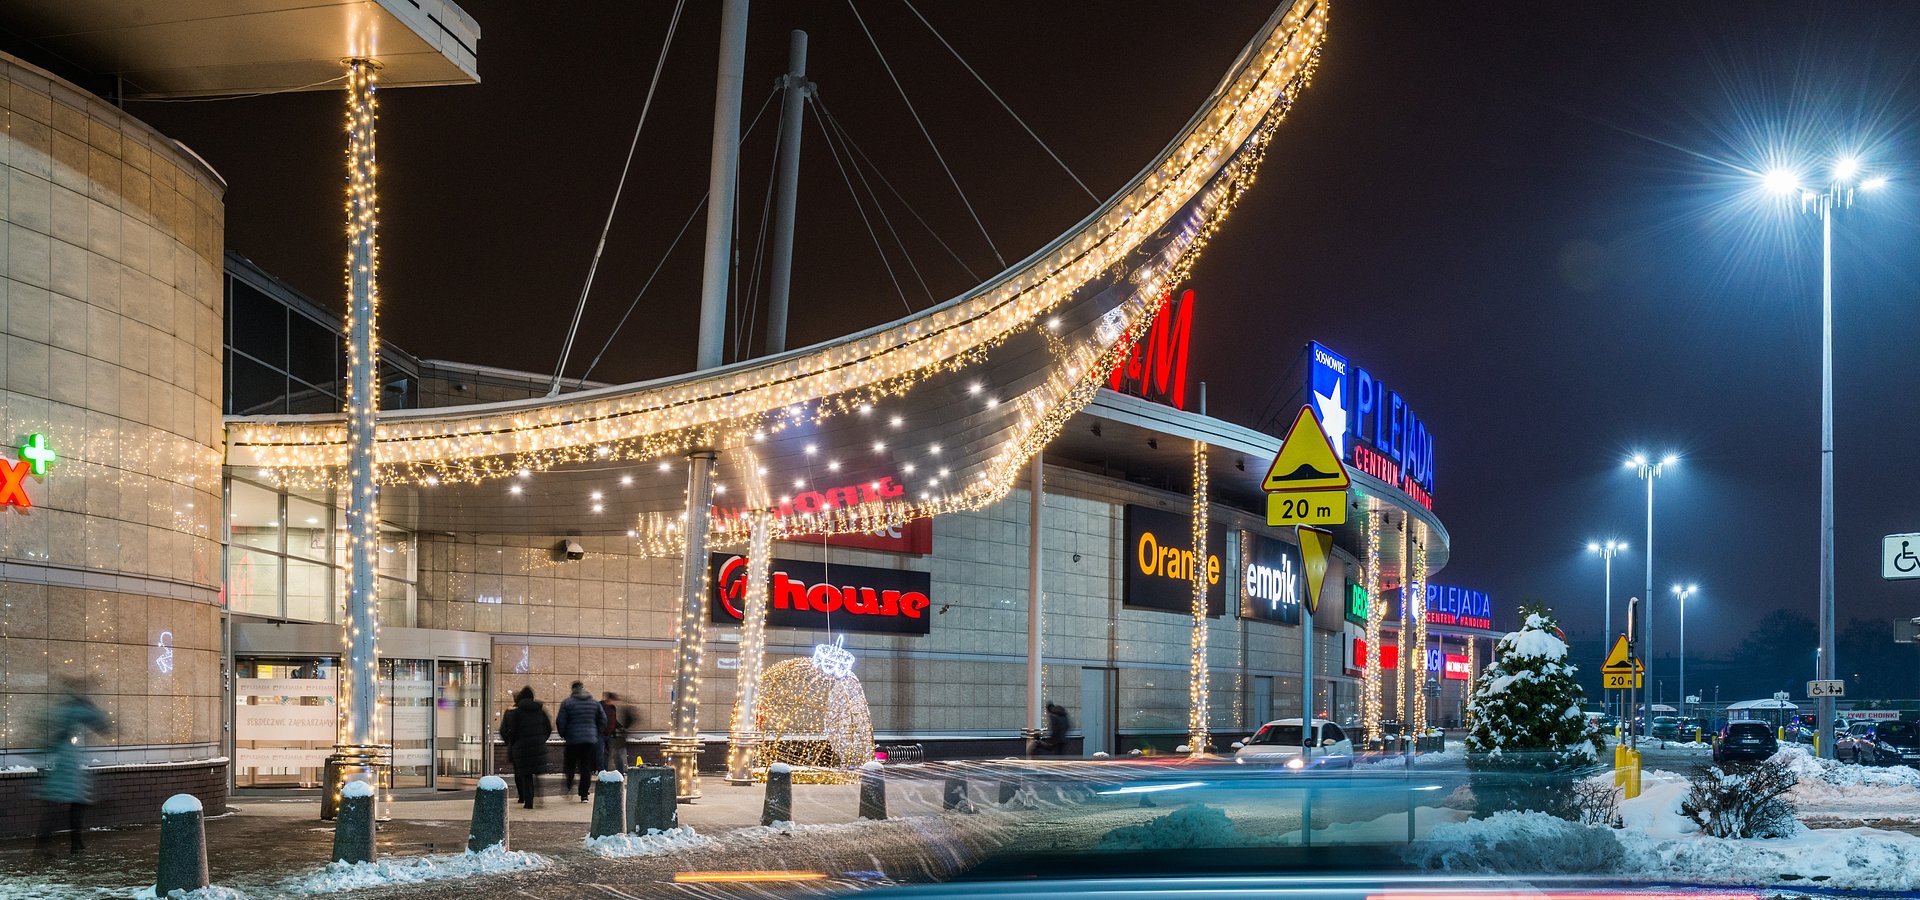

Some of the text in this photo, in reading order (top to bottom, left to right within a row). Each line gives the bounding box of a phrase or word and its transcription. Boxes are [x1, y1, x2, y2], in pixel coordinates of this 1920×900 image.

[1092, 283, 1194, 410] &M
[1315, 349, 1346, 376] SOSNOWIEC
[1354, 366, 1434, 495] PLEJADA
[1355, 445, 1399, 488] CENTRUM
[1282, 499, 1331, 519] 20 m
[1138, 531, 1220, 585] Orane
[773, 571, 930, 619] house
[1246, 553, 1297, 610] empik
[1426, 584, 1491, 620] PLEJADA
[1426, 612, 1491, 630] CENTRUM HANDLOWE
[1610, 676, 1625, 686] 20
